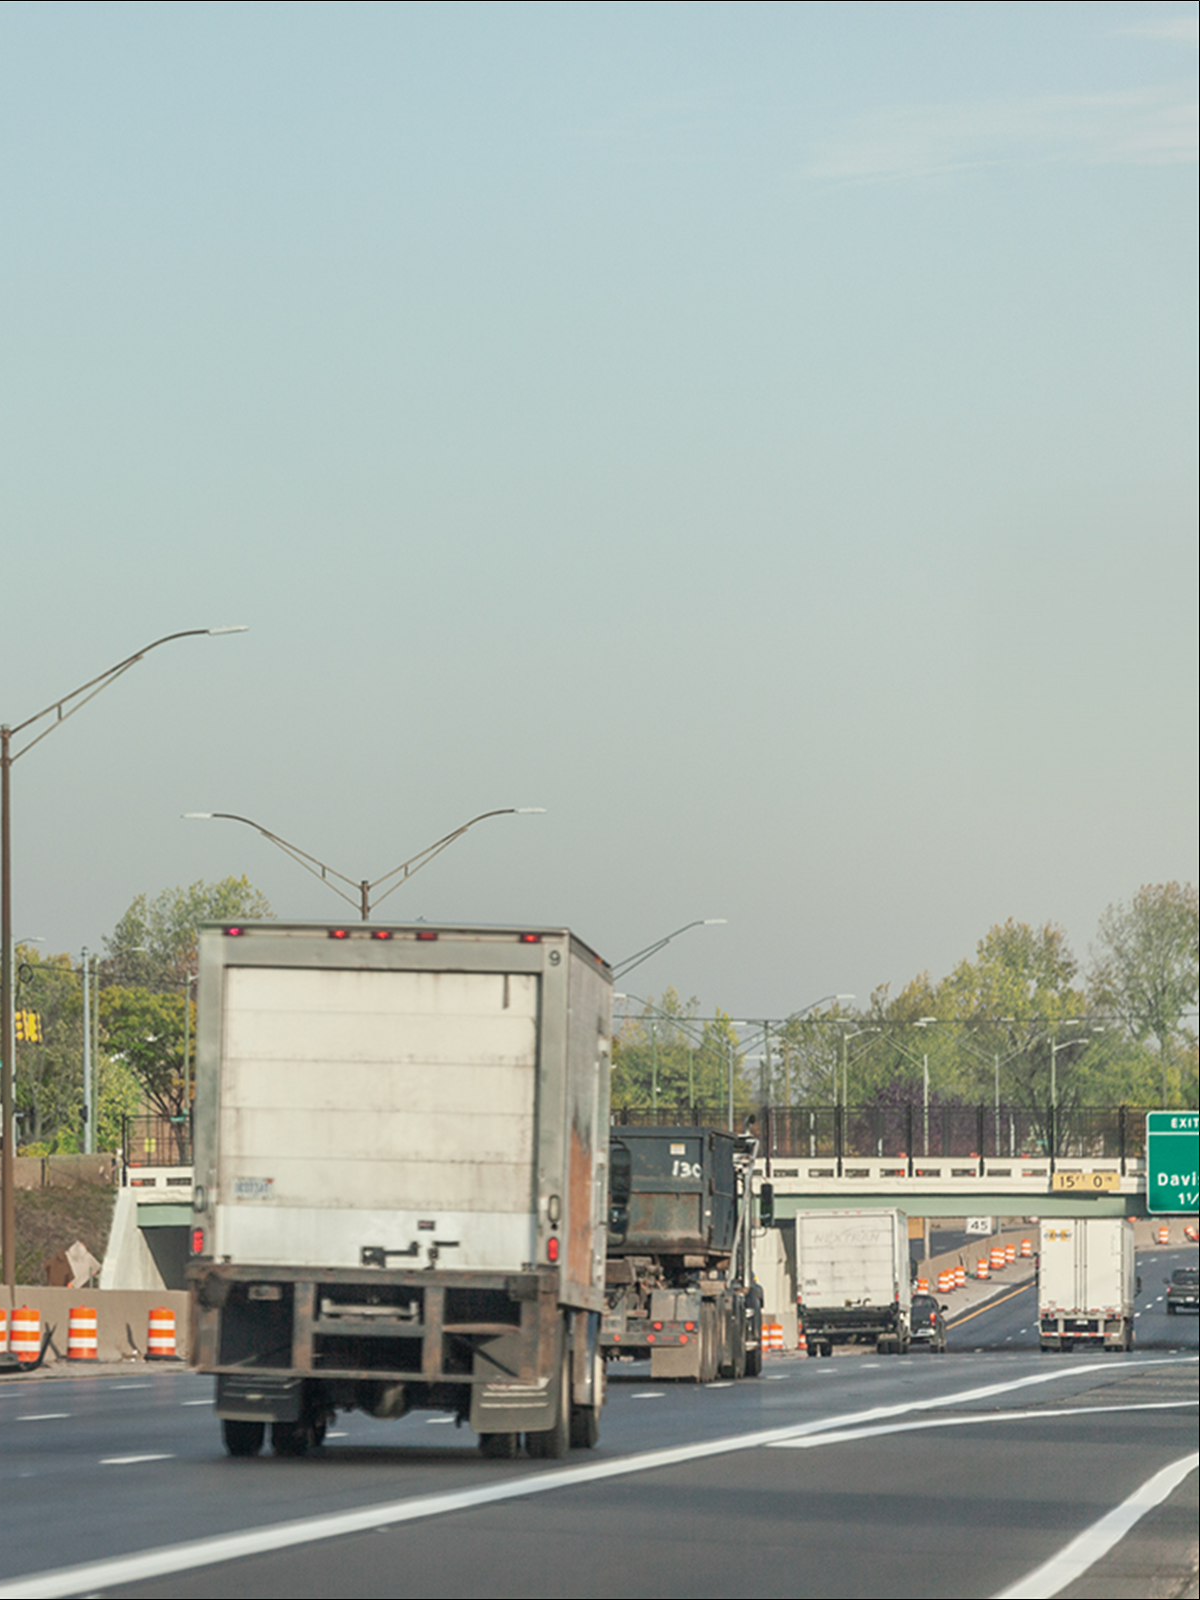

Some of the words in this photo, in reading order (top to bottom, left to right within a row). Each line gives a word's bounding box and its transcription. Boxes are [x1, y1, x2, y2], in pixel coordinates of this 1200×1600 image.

[548, 949, 561, 967] 9
[1170, 1117, 1198, 1129] EXIT
[1157, 1171, 1199, 1187] Davi
[970, 1220, 988, 1231] 45
